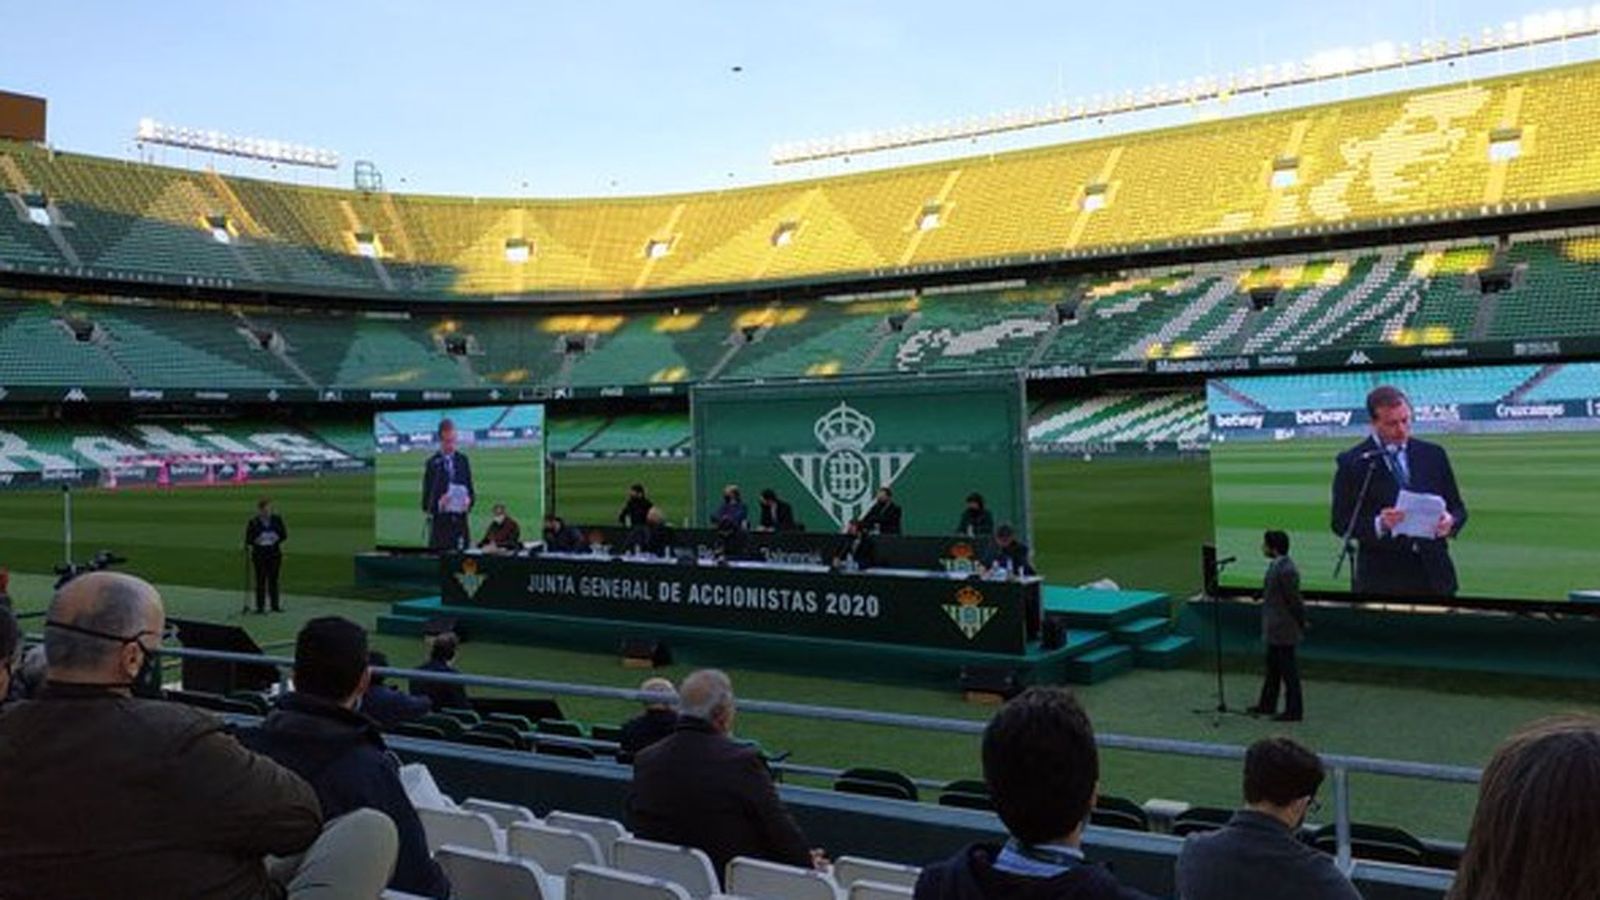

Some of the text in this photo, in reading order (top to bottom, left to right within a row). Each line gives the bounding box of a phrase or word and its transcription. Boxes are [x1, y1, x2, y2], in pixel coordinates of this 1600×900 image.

[1216, 414, 1264, 429] betway
[1297, 411, 1352, 426] betway
[528, 574, 879, 617] JUNTA GENERAL DE ACCIONISTAS 2020
